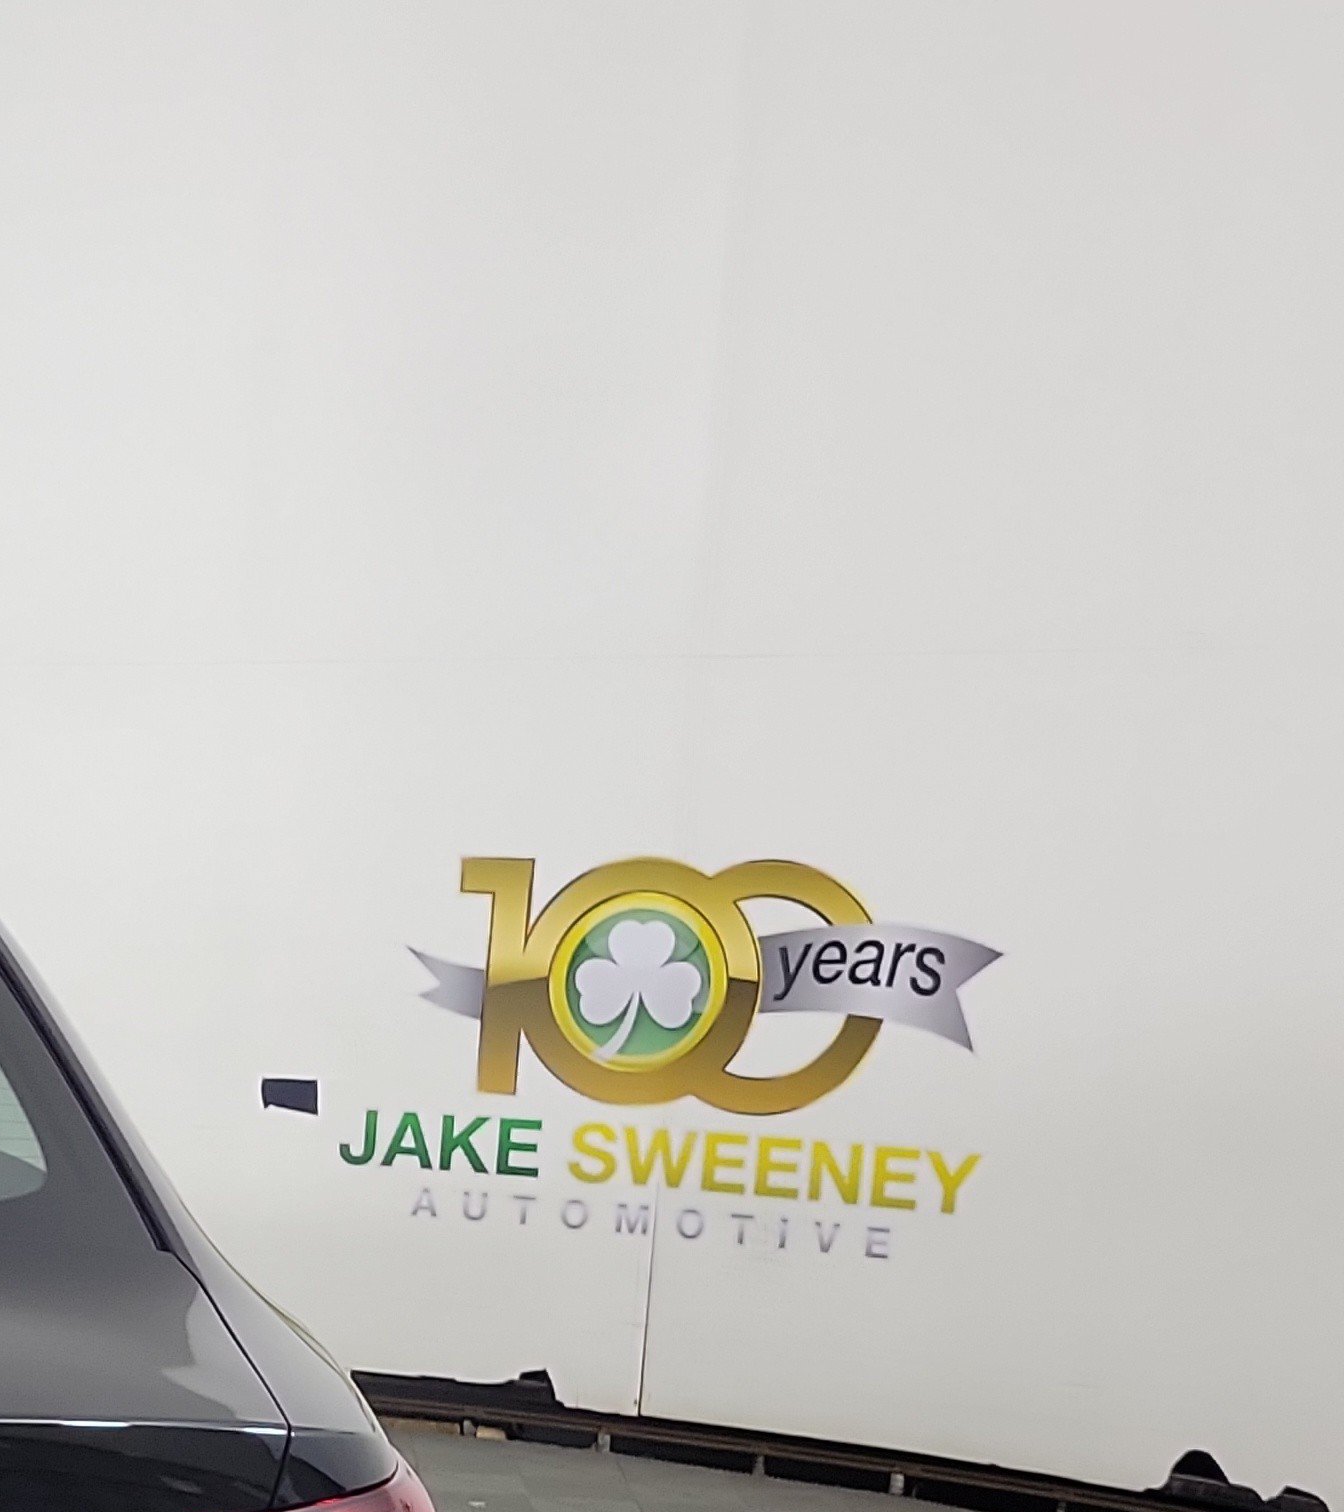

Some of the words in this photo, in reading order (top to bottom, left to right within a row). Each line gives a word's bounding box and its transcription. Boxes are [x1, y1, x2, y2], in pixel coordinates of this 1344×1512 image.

[459, 856, 884, 1115] 100
[773, 936, 947, 1001] years
[338, 1109, 544, 1178] JAKE
[566, 1122, 982, 1217] SWEENEY
[410, 1187, 892, 1260] AUTOMOTIVE
